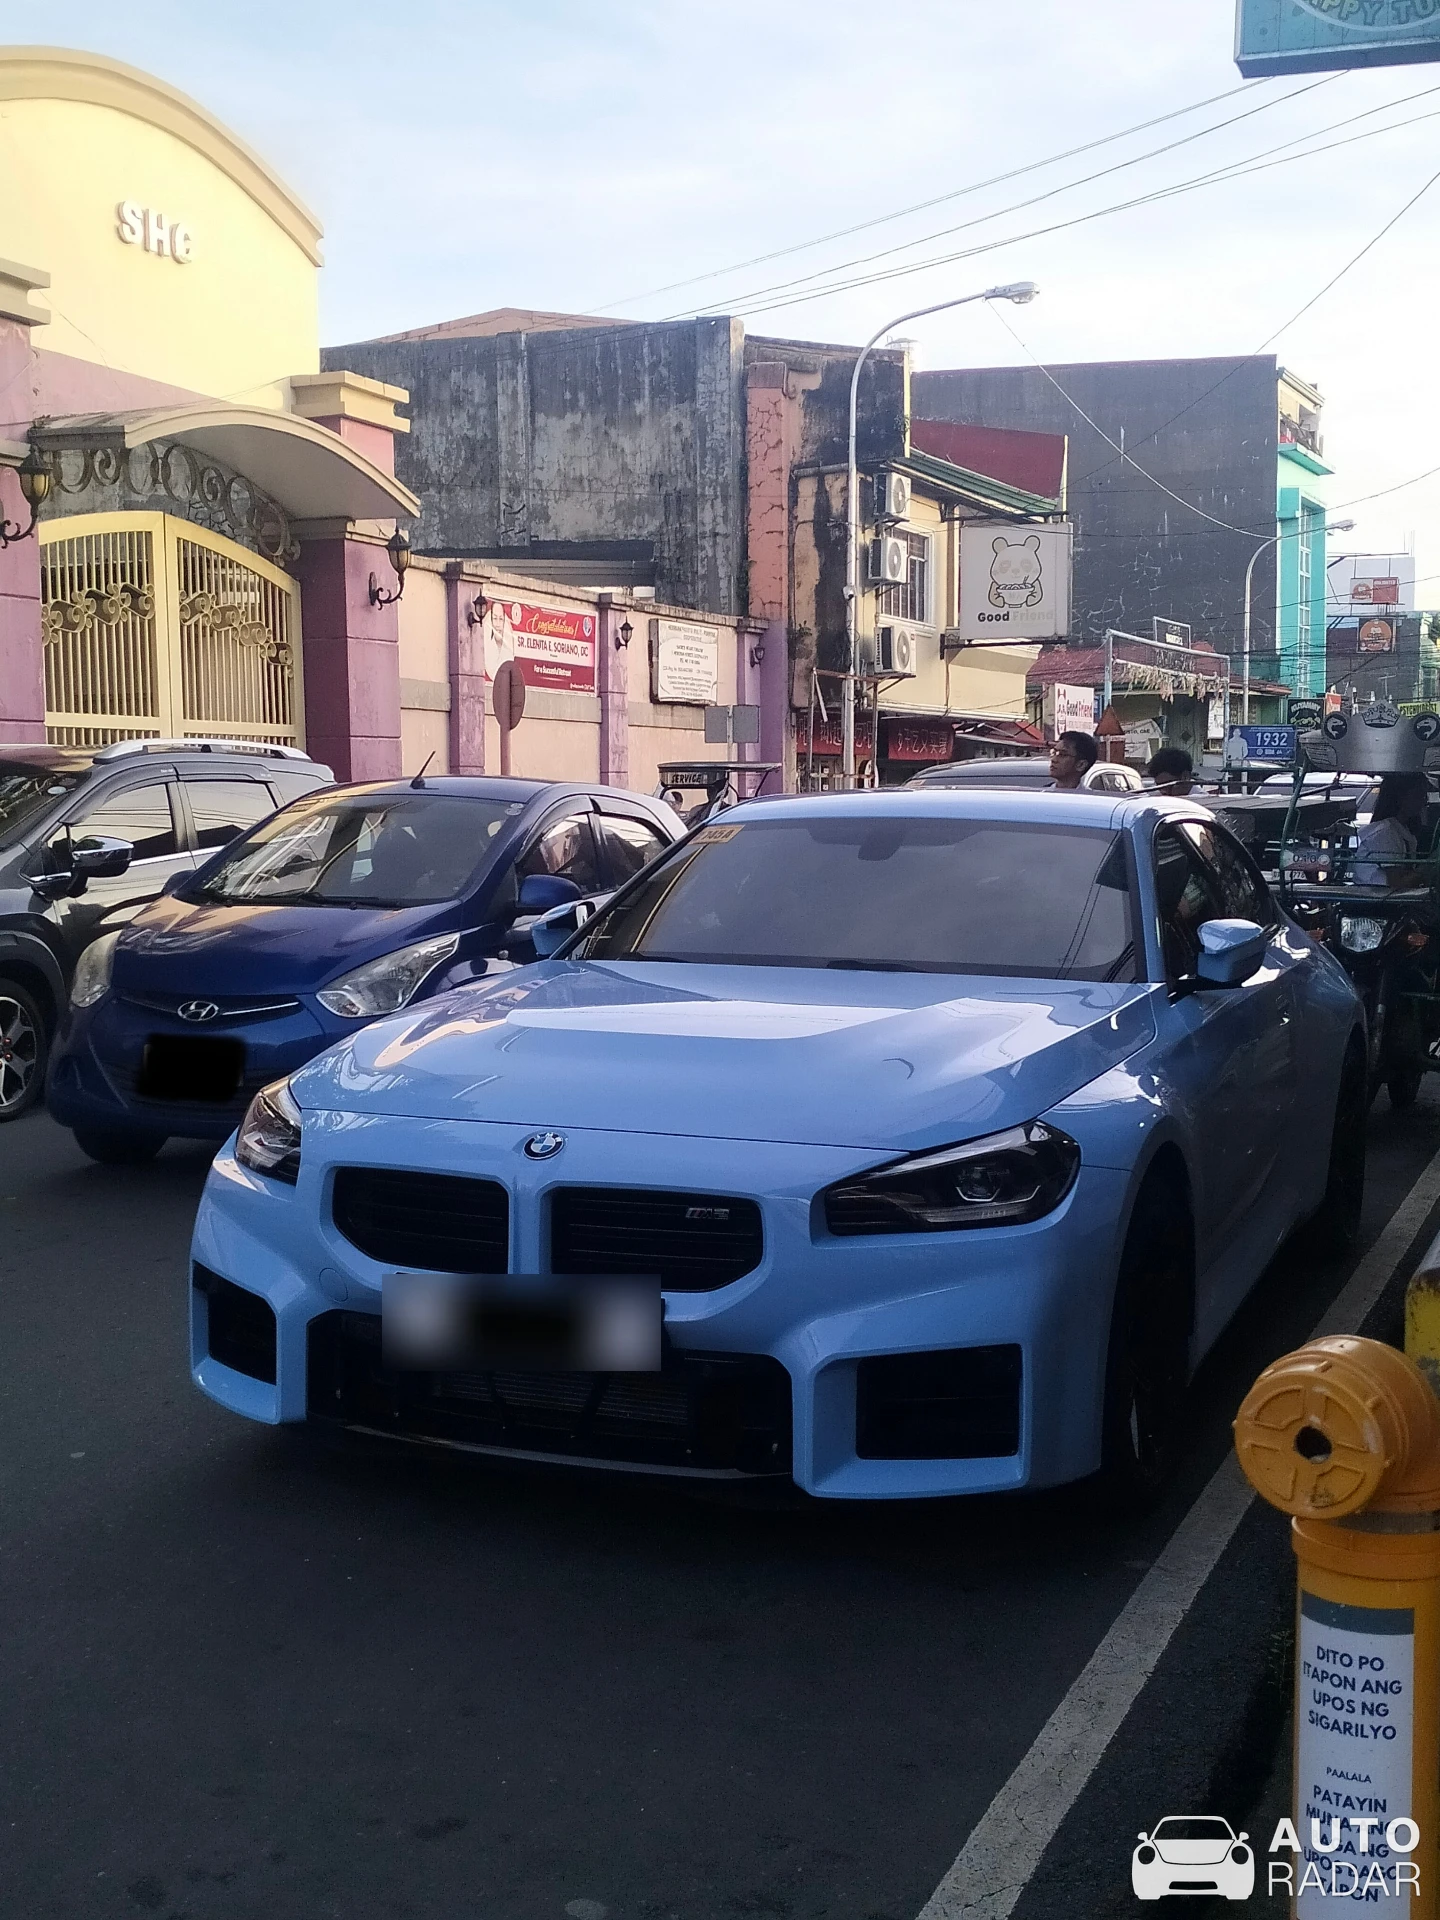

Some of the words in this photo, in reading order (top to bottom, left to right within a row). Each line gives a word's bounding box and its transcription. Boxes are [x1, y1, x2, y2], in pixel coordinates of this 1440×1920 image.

[977, 611, 1010, 622] Good
[1013, 608, 1053, 620] Friend
[517, 636, 527, 648] SR.
[527, 637, 548, 651] ELENITA
[554, 642, 580, 657] SORIANO,
[1256, 732, 1288, 746] 1932
[671, 774, 702, 784] SERVICE
[1316, 1645, 1353, 1668] DITO
[1358, 1656, 1385, 1672] PO
[1303, 1662, 1356, 1691] ITAPON
[1361, 1680, 1403, 1695] ANG
[1313, 1688, 1356, 1714] UPOS
[1361, 1702, 1390, 1717] NG
[1308, 1710, 1397, 1740] SIGARILYO
[1326, 1767, 1372, 1783] PAALALA
[1313, 1785, 1387, 1813] PATAYIN
